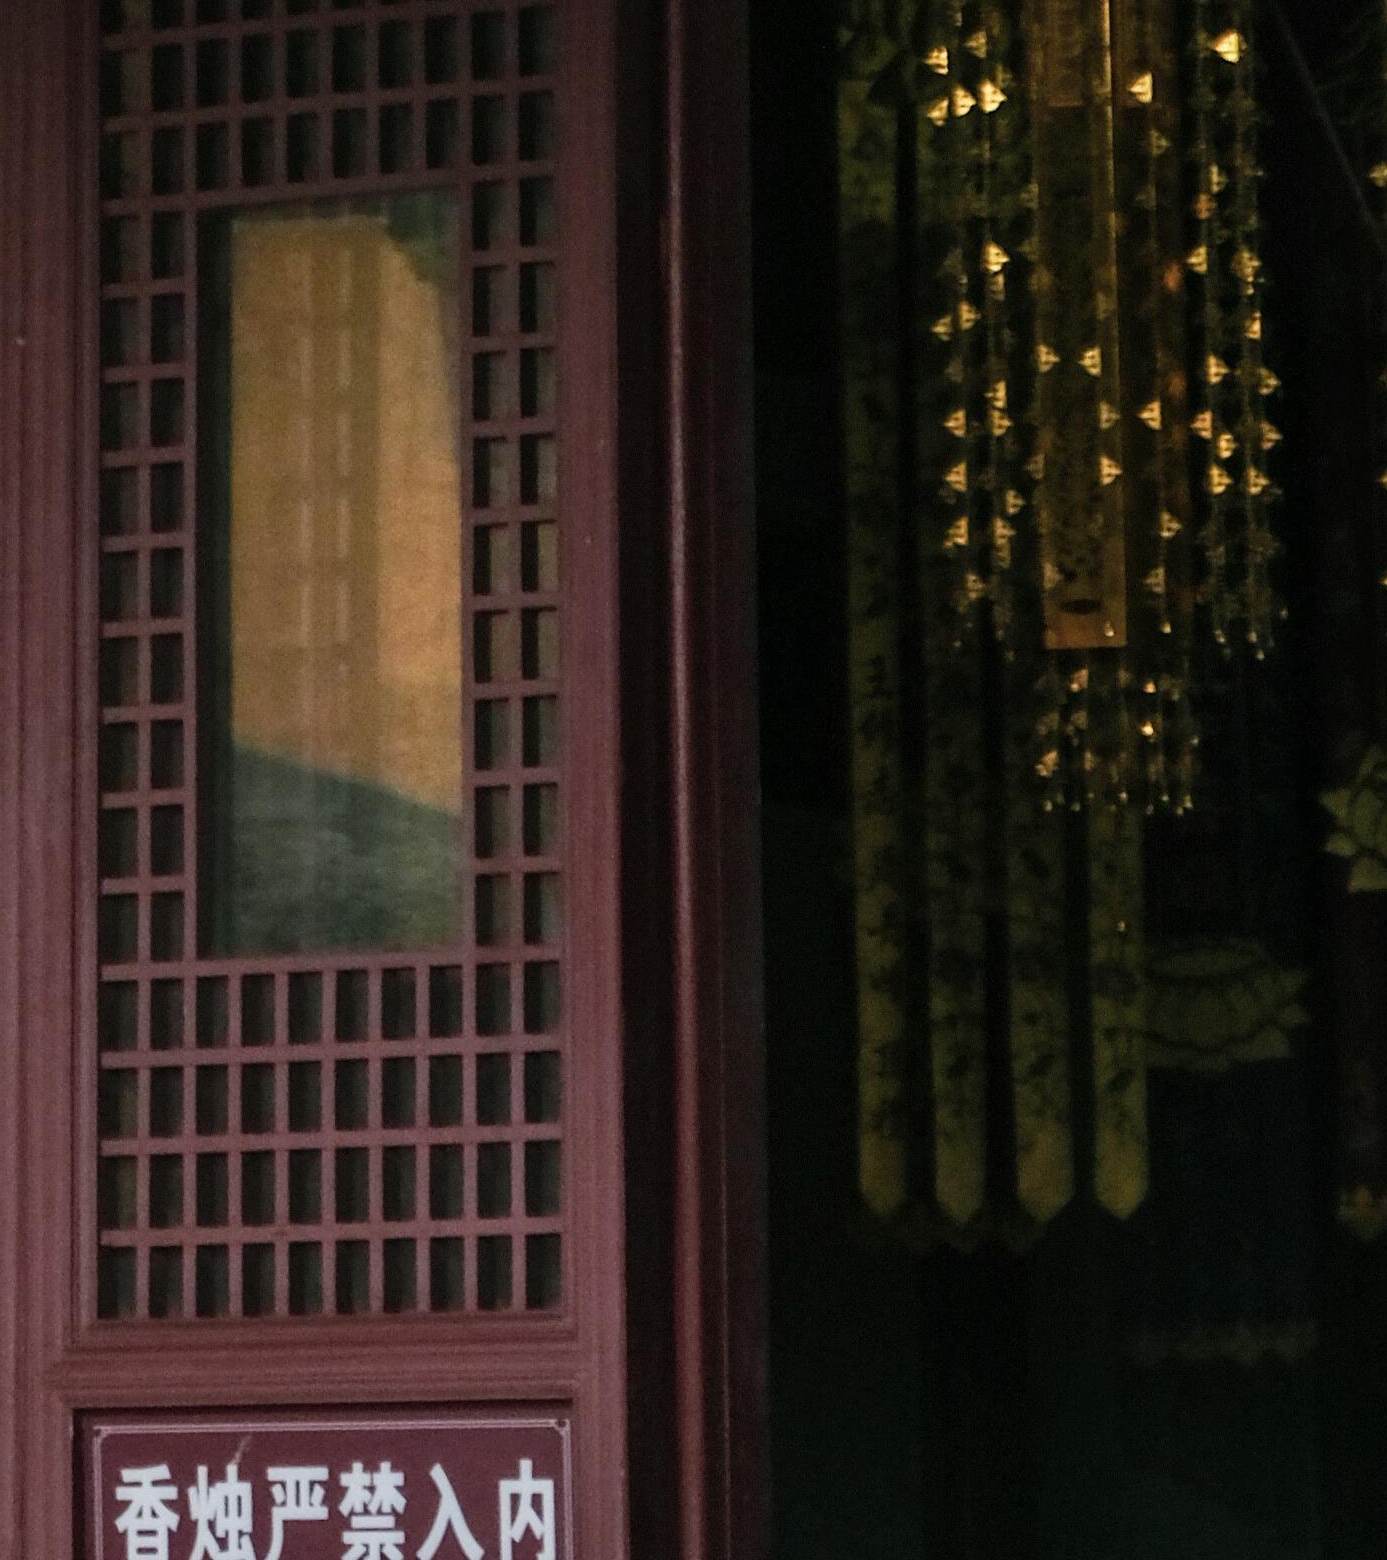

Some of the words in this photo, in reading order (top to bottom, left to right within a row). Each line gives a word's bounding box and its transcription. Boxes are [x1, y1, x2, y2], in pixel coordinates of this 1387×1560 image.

[114, 1458, 556, 1560] 香烛严禁入内
